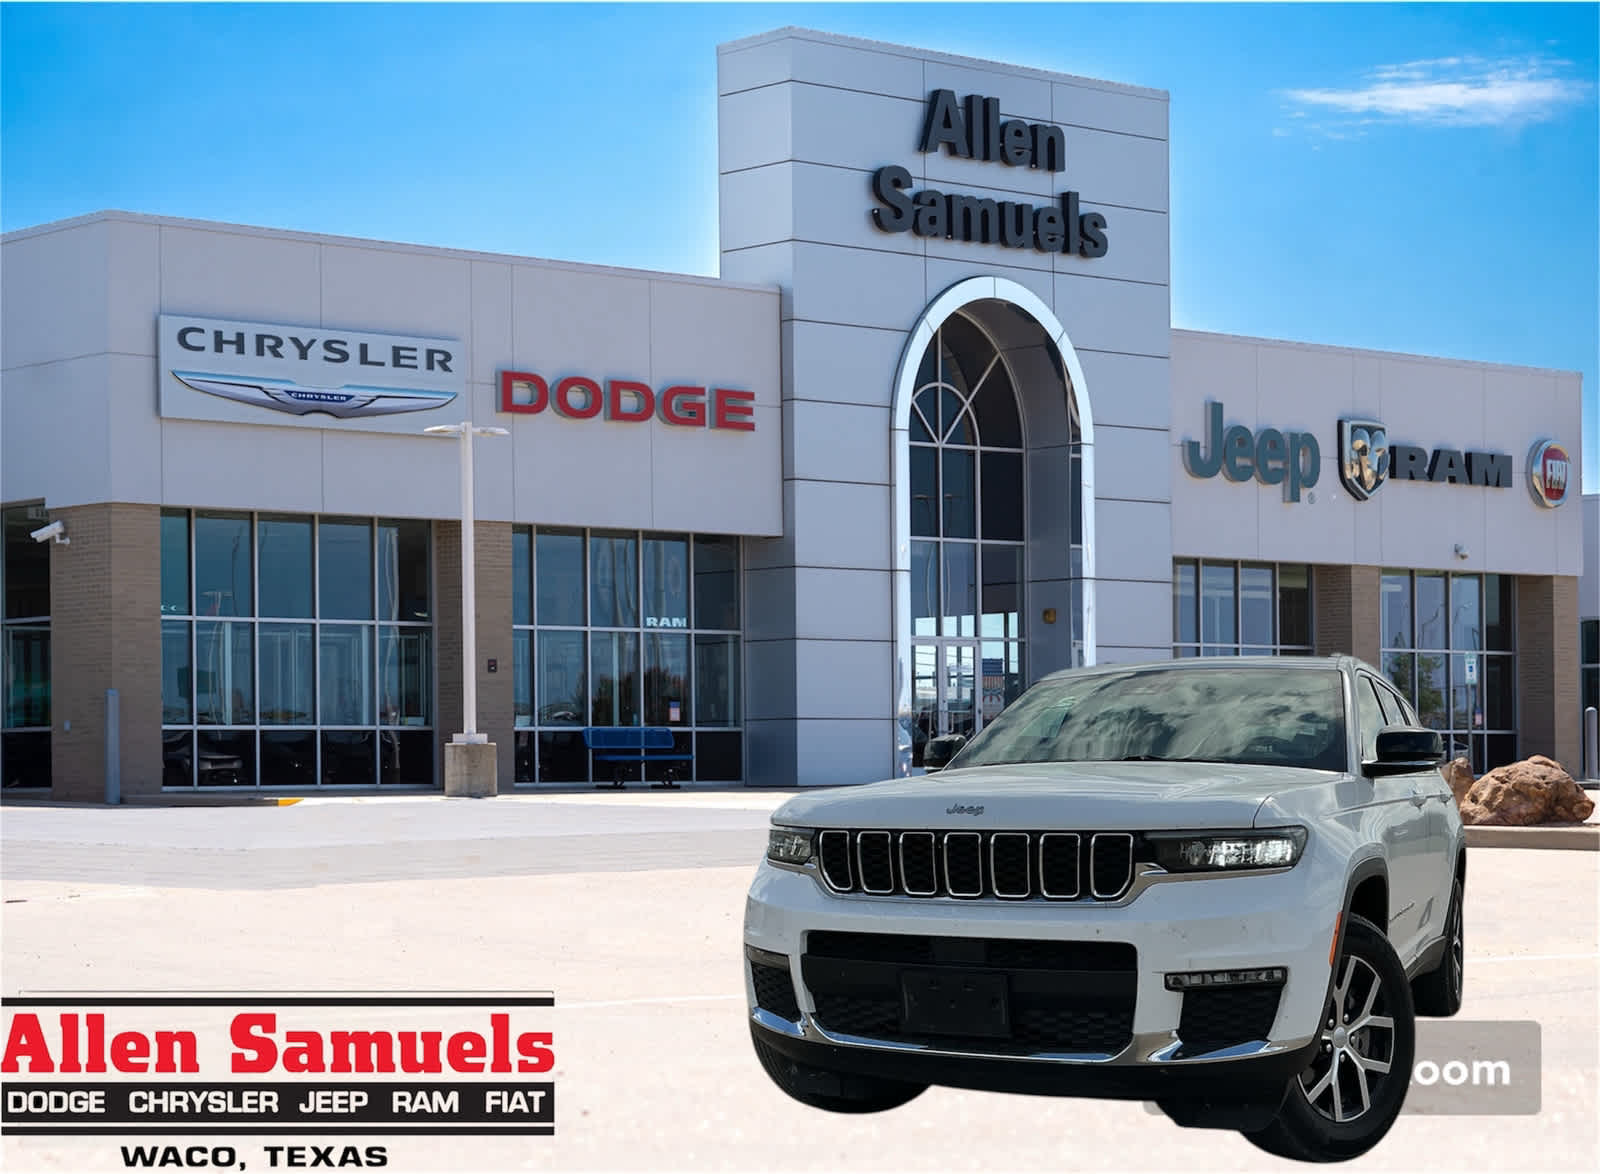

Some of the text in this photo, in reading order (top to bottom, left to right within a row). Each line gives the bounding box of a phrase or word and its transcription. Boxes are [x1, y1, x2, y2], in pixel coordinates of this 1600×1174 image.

[918, 88, 1066, 173] Allen
[871, 165, 1109, 259] Samuels
[176, 326, 454, 373] CHRYSLER
[289, 391, 350, 402] CHRYSLER
[495, 370, 756, 432] DODGE
[1182, 400, 1321, 503] Jeep
[1389, 445, 1513, 488] RAM
[1546, 459, 1568, 489] FIAT
[645, 616, 687, 628] RAM
[946, 803, 985, 816] Jeep
